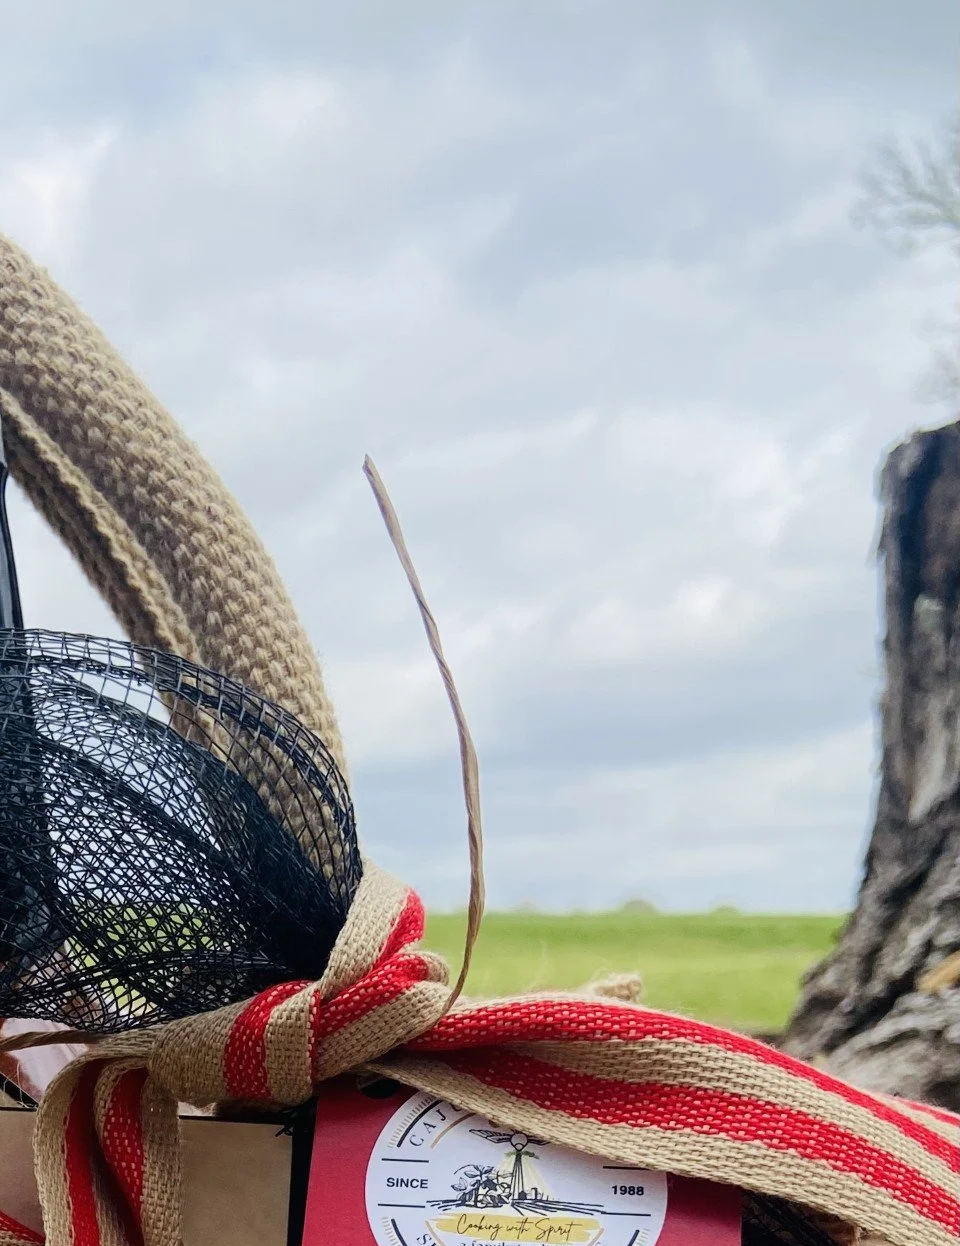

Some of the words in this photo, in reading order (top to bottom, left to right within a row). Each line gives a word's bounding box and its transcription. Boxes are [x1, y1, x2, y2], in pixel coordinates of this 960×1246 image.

[386, 1177, 429, 1190] SINCE
[611, 1184, 644, 1197] 1988
[456, 1213, 504, 1241] Cooking
[506, 1216, 533, 1239] with
[534, 1217, 583, 1242] Spirit
